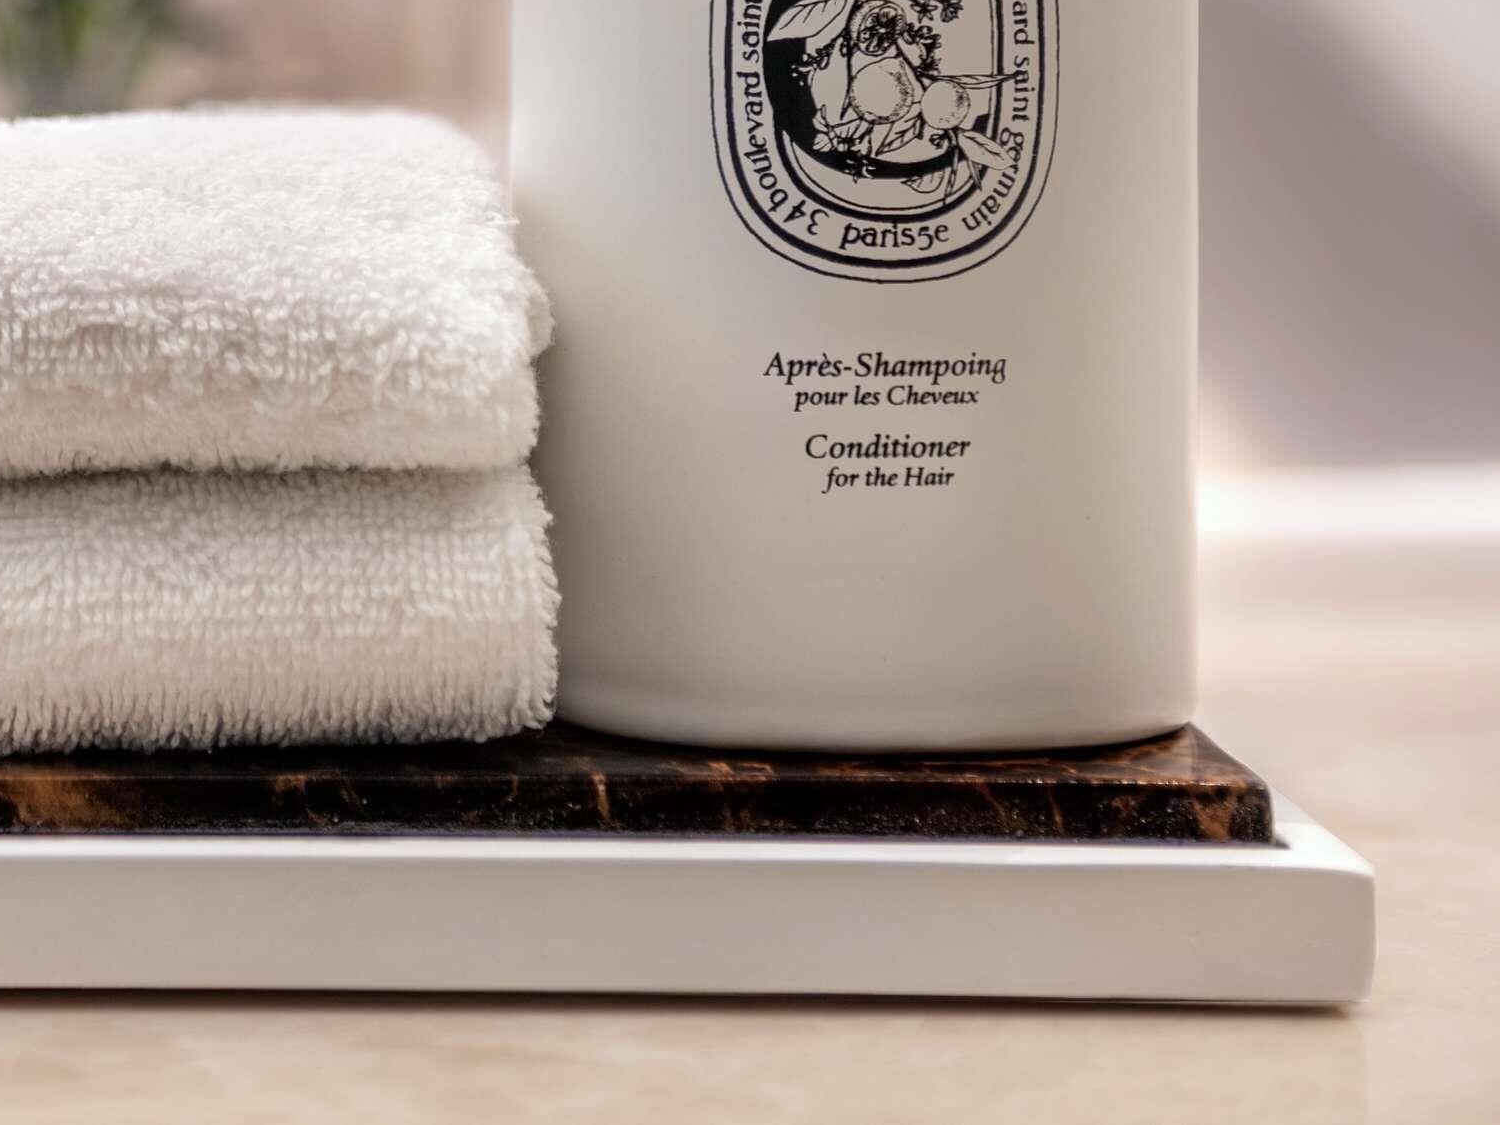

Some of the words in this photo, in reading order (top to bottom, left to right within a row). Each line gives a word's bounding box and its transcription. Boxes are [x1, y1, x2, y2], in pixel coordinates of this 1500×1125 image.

[1011, 55, 1035, 122] saint
[961, 127, 1025, 231] germain
[763, 351, 1007, 386] Après-Shampoing
[793, 388, 849, 412] pour
[853, 384, 881, 406] les
[887, 384, 980, 406] Cheveux
[804, 433, 971, 459] Conditioner
[821, 466, 859, 495] for
[864, 466, 898, 487] the
[903, 466, 956, 487] Hair
